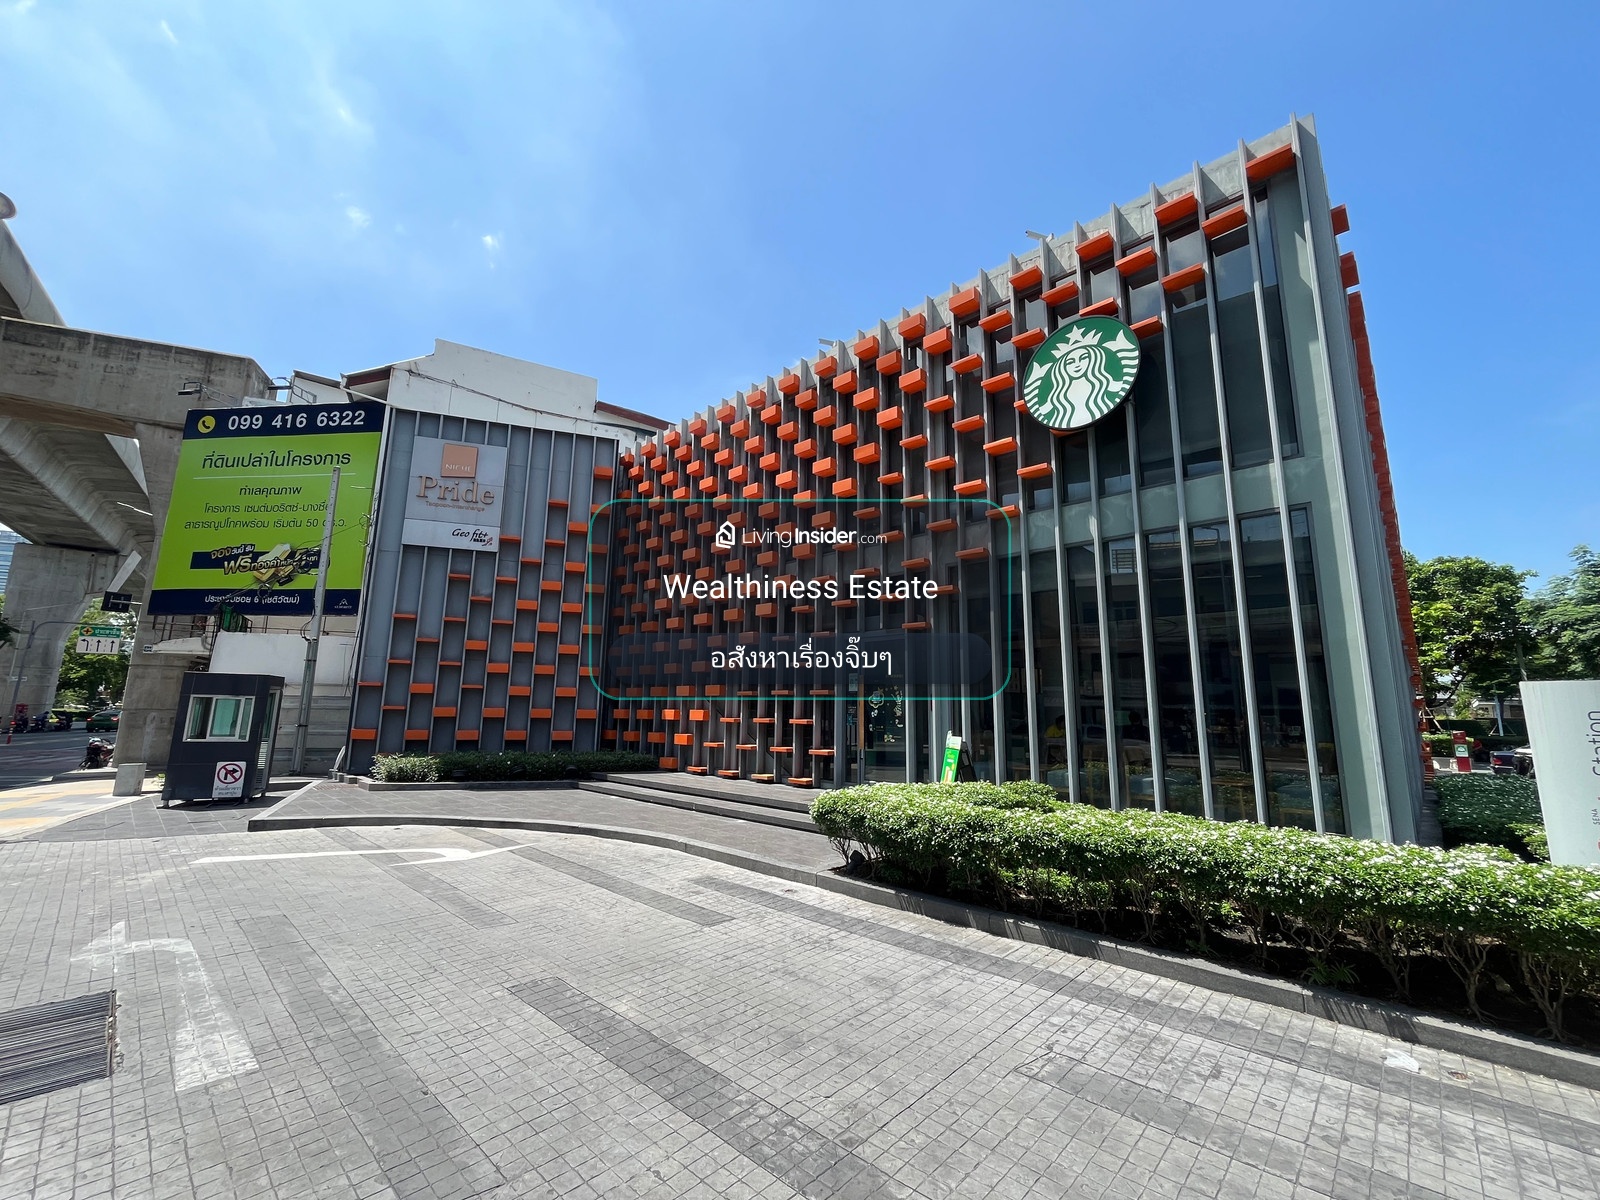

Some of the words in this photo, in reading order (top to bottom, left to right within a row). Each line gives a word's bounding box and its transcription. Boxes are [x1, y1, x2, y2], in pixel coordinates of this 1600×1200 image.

[228, 415, 263, 430] 099
[271, 413, 307, 429] 416
[316, 410, 365, 427] 6322
[202, 450, 351, 469] ที่ดินเปล่าในโครงการ
[239, 485, 302, 498] ทำเลคุณภาพ
[416, 475, 495, 505] Pride
[204, 502, 240, 514] โครงการ
[306, 518, 318, 527] 50
[452, 528, 470, 538] Geo
[254, 595, 259, 603] 6
